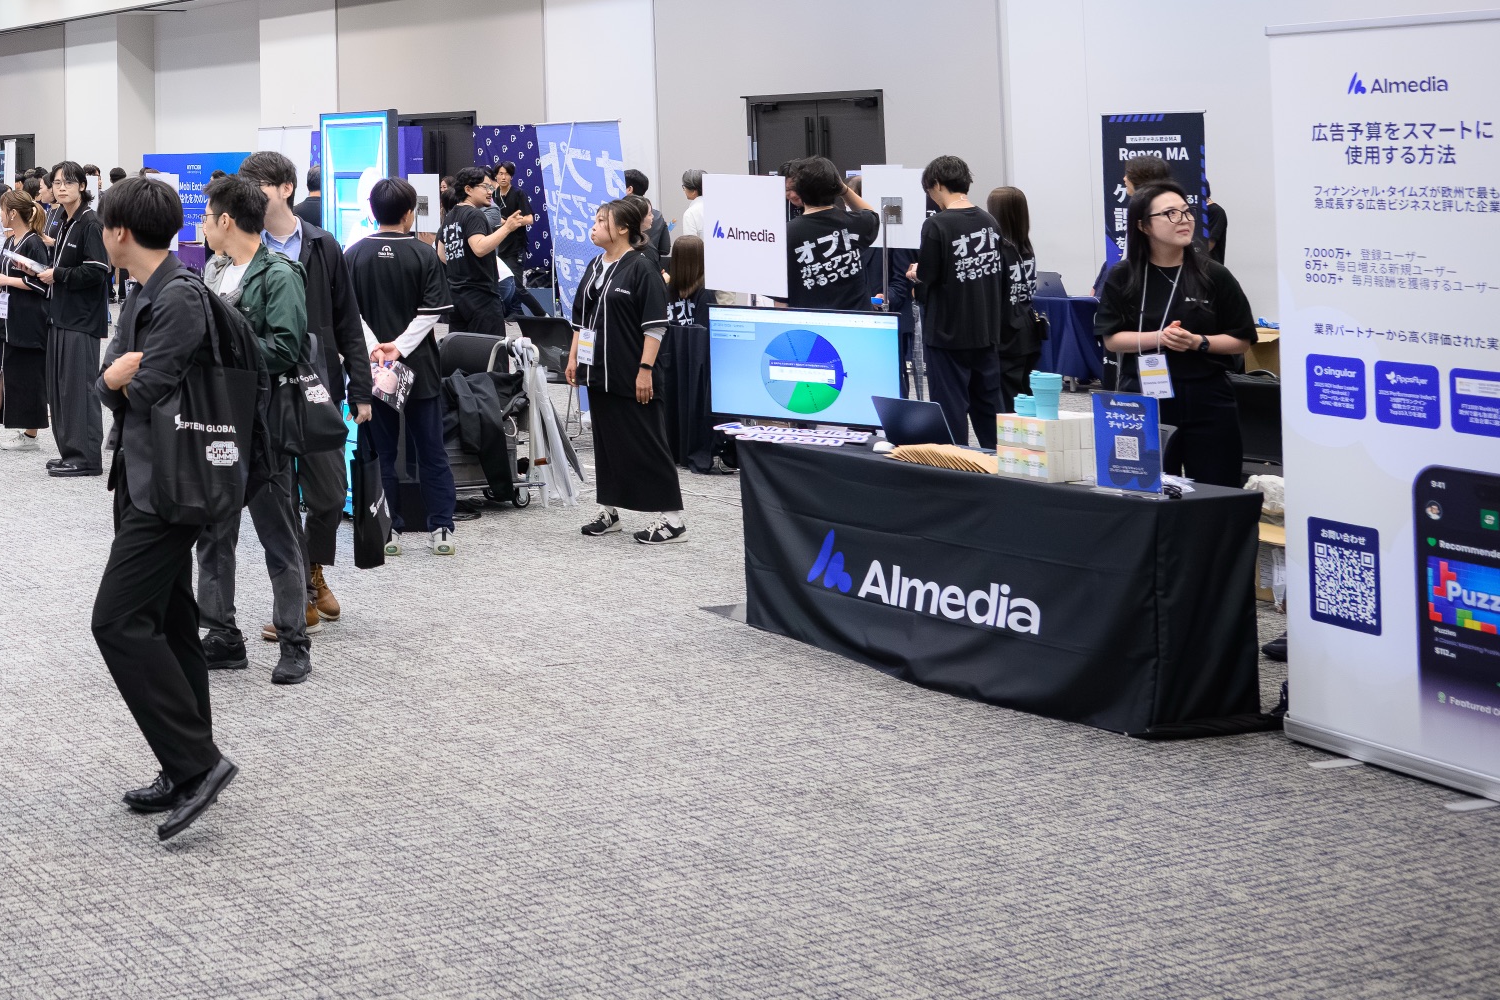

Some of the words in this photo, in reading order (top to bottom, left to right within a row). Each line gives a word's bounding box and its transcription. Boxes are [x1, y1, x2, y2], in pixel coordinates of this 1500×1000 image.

[1370, 76, 1449, 94] Almedia
[1311, 120, 1494, 142] 広告予算をスマートに
[1166, 147, 1190, 161] MA
[1345, 144, 1457, 165] 使用する方法
[1314, 197, 1500, 213] 急成長する広告ビジネスと評した企業
[726, 227, 776, 243] Almedia
[952, 227, 1000, 257] オプト
[794, 228, 860, 264] オプト
[1360, 248, 1427, 262] 登録ユーザー
[800, 249, 861, 279] ガチでアプリ
[955, 250, 1001, 271] ガチでアプリ
[1009, 257, 1037, 282] オプ
[1305, 260, 1329, 271] 6万+
[1336, 261, 1457, 278] 毎日増える新規ユーザー
[803, 260, 863, 290] やるってよ!
[956, 261, 1002, 283] やるってよ!
[1305, 273, 1344, 285] 900万+
[1351, 274, 1500, 293] 毎月報酬を獲得するユーザー
[1323, 366, 1357, 379] singular
[1105, 411, 1146, 422] スキャンして
[1108, 420, 1143, 430] チャレンジ
[206, 424, 237, 434] GLOBAL
[1320, 528, 1367, 546] お問い合わせ
[857, 559, 1041, 635] Almedia
[1449, 695, 1492, 715] Featured
